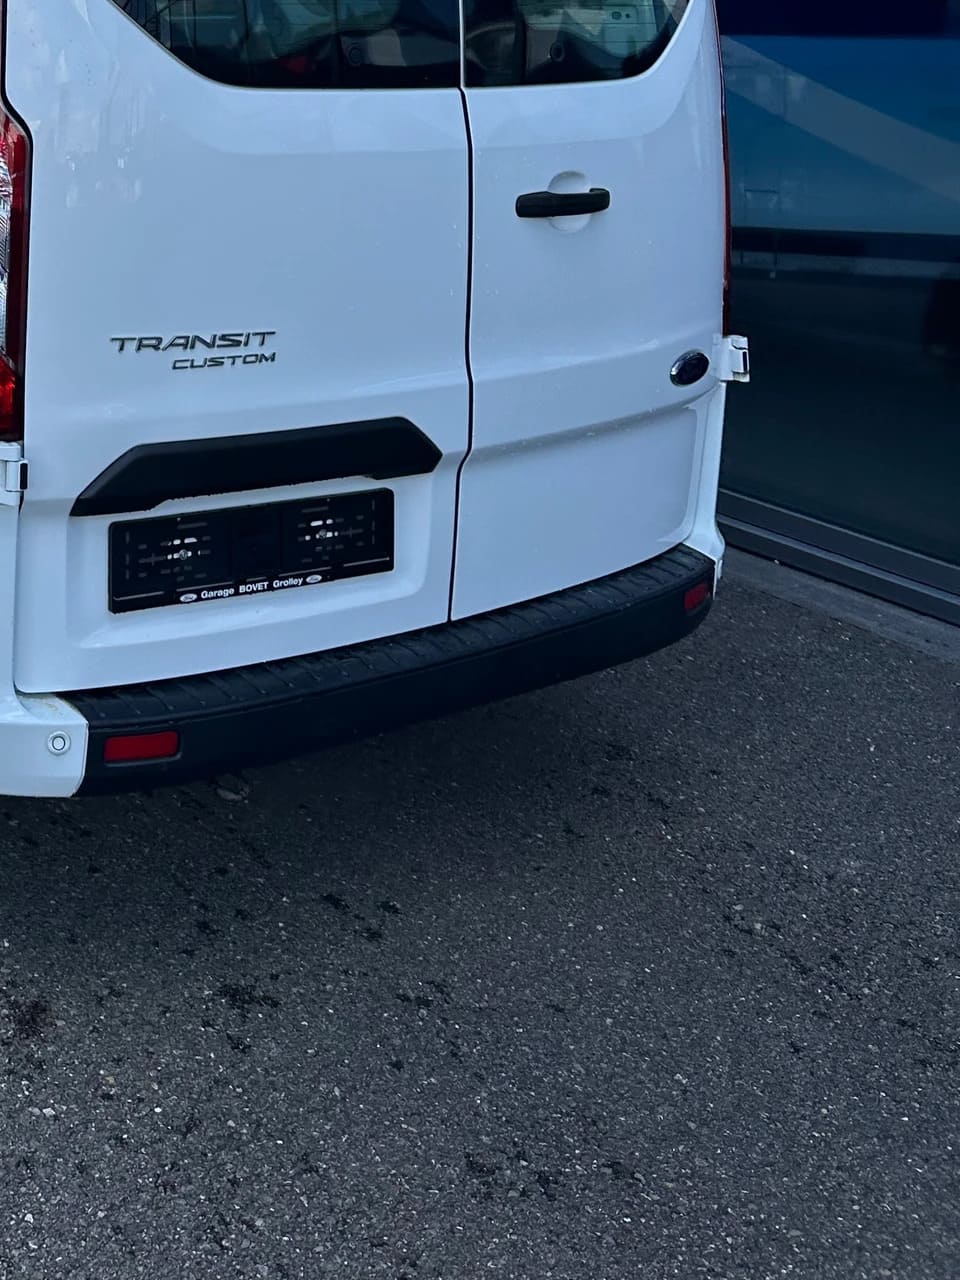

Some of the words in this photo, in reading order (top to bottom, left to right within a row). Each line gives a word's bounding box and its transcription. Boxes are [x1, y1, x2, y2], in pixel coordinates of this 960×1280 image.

[109, 331, 276, 353] TRANSIT
[171, 352, 276, 371] CUSTOM
[200, 587, 235, 599] Garage
[239, 582, 269, 593] BOVET
[272, 577, 303, 588] Grolley
